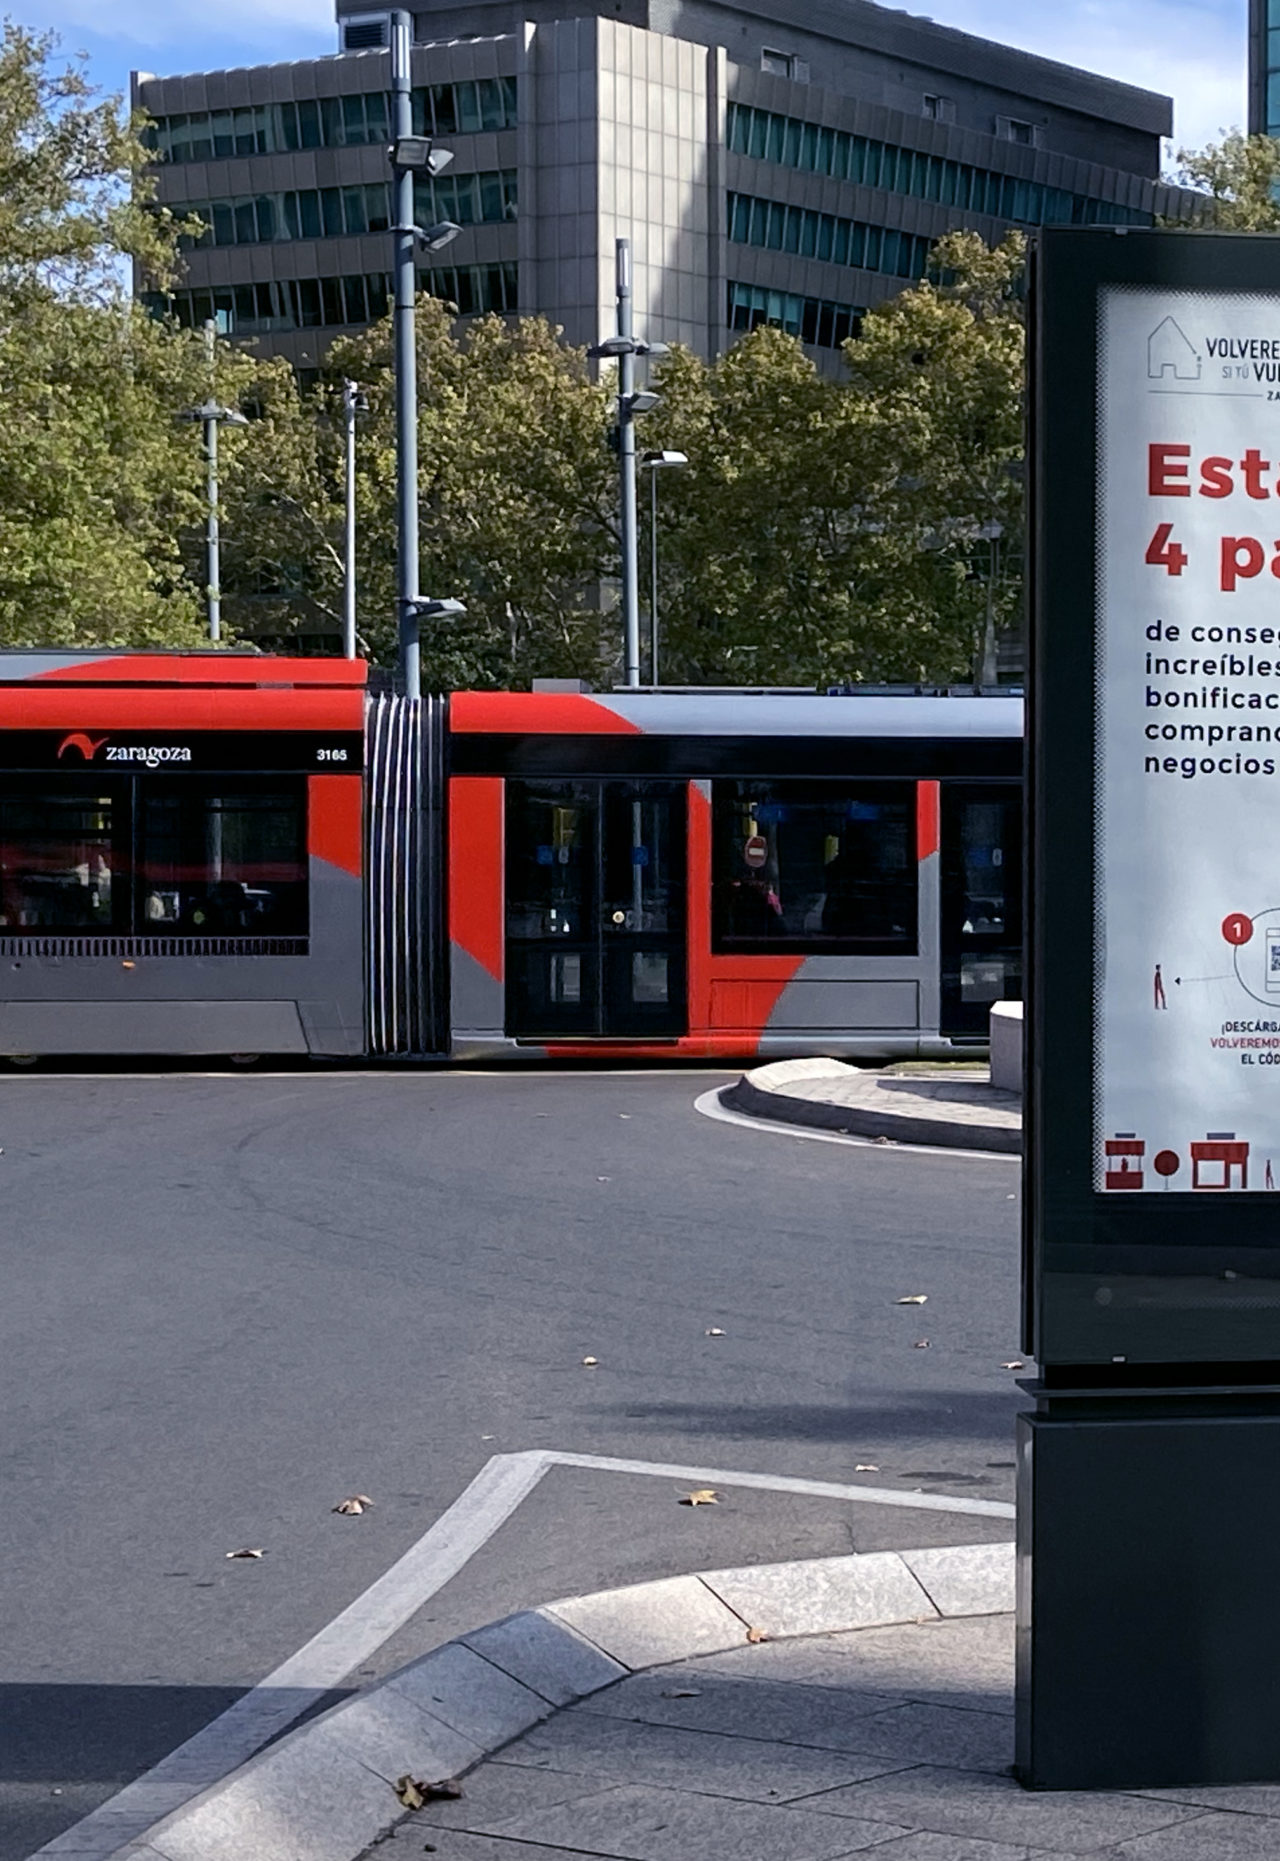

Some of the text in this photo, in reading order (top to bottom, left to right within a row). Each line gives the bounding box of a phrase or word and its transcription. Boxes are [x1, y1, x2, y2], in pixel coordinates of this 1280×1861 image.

[1222, 365, 1232, 379] SI
[1236, 363, 1249, 379] TÚ
[1145, 522, 1189, 577] 4
[1145, 619, 1181, 642] de
[106, 745, 192, 768] zaragoza
[316, 749, 348, 761] 3165
[1144, 753, 1275, 778] negocios
[1241, 1053, 1254, 1065] EL
